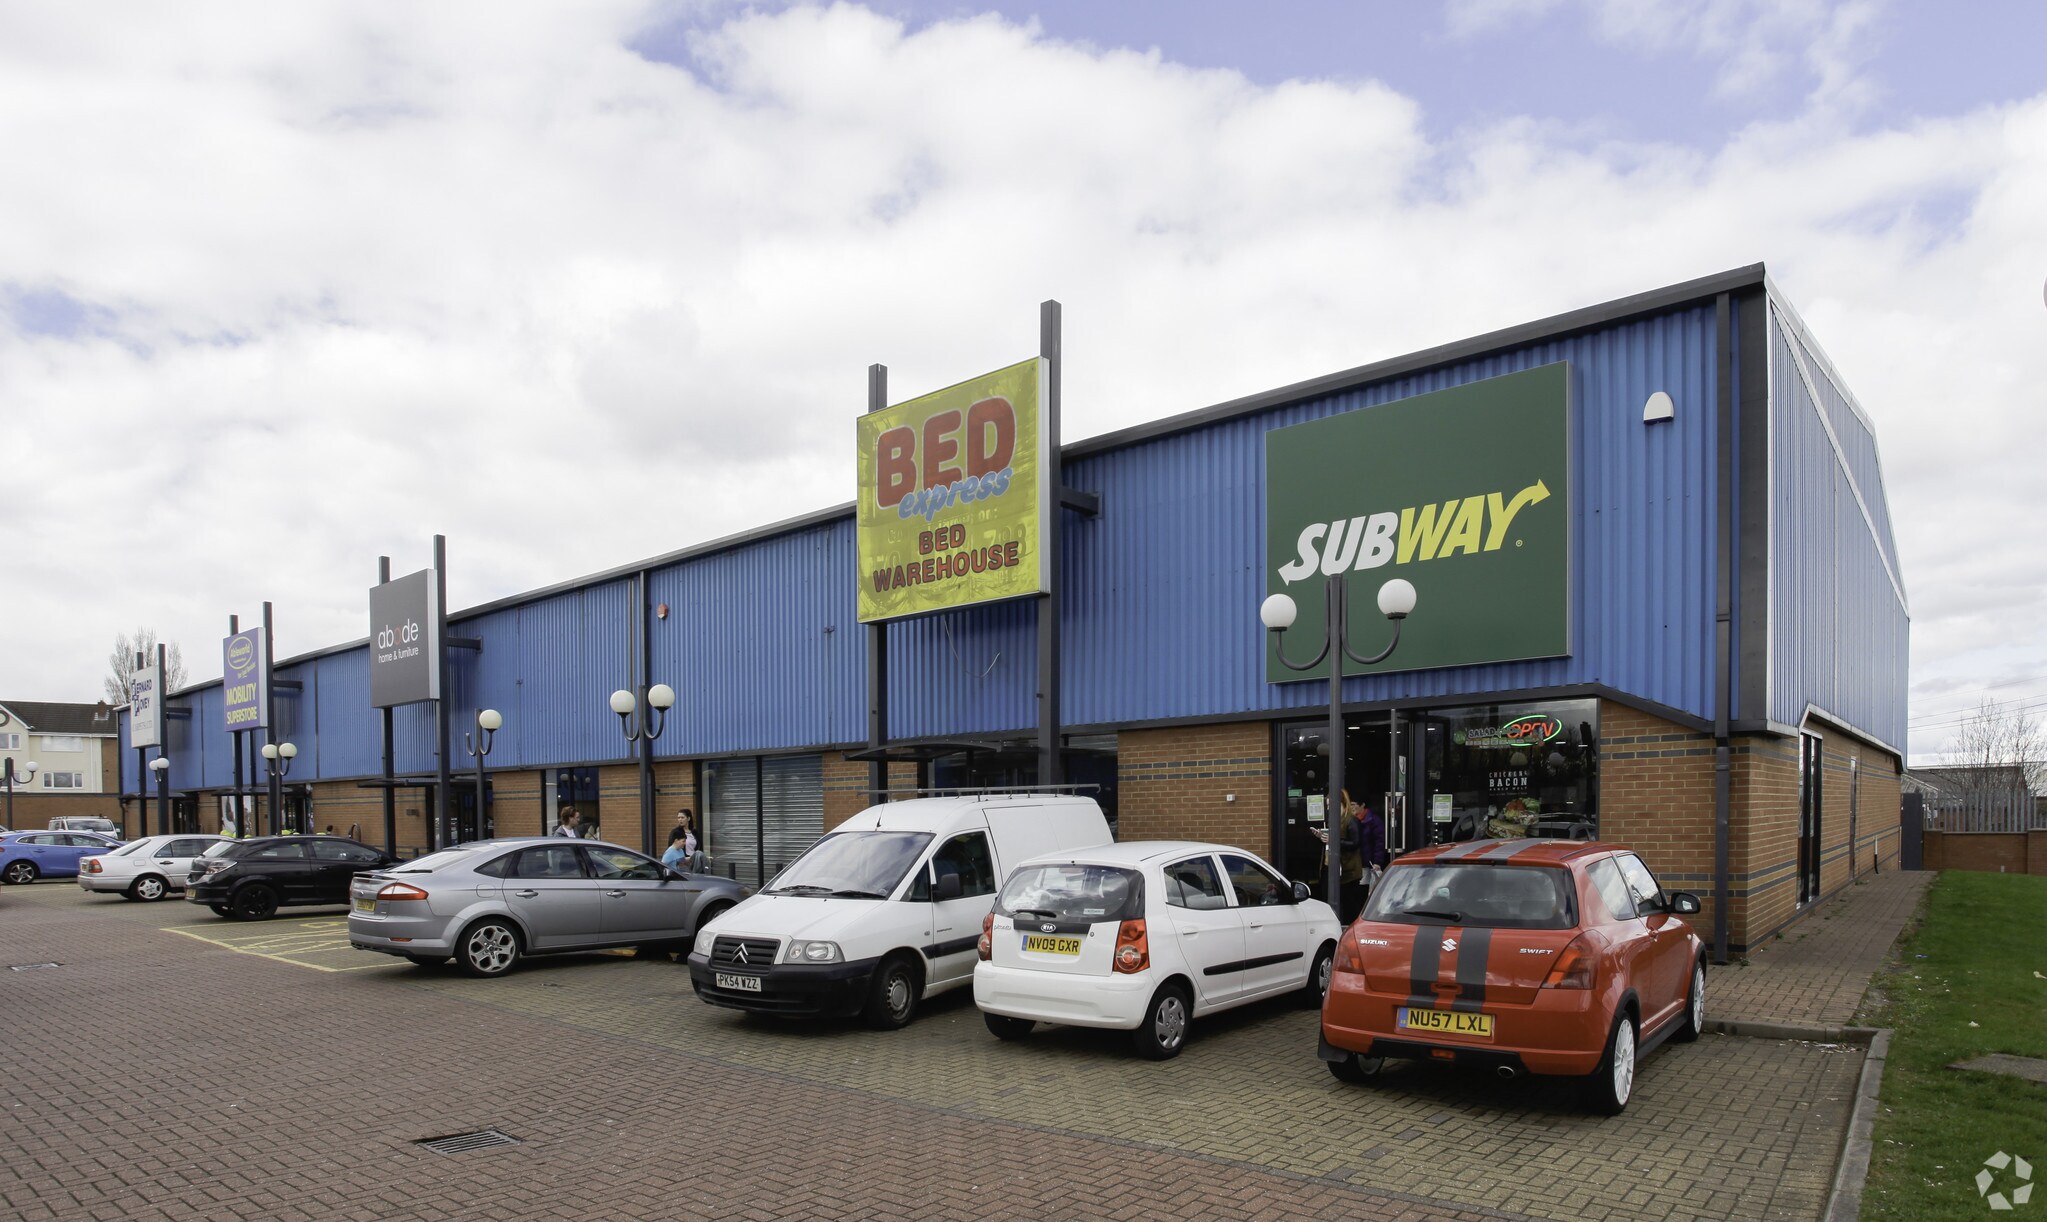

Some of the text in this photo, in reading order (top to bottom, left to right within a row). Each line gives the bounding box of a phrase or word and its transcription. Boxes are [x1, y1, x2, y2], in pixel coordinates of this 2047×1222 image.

[876, 396, 1016, 510] BED
[898, 467, 1013, 522] express
[919, 524, 966, 555] BED
[1278, 479, 1550, 586] SUBWAY
[873, 541, 1019, 593] WAREHOUSE
[378, 619, 418, 649] abode
[378, 654, 392, 663] home
[393, 651, 398, 660] &
[226, 683, 257, 706] MOBILITY
[227, 706, 257, 724] SUPERSTORE
[1468, 727, 1496, 738] SALAD
[1489, 778, 1528, 787] BACON
[1028, 938, 1079, 952] NV09 GXR
[720, 975, 739, 987] PK54
[1409, 1010, 1488, 1032] NU57 LXL
